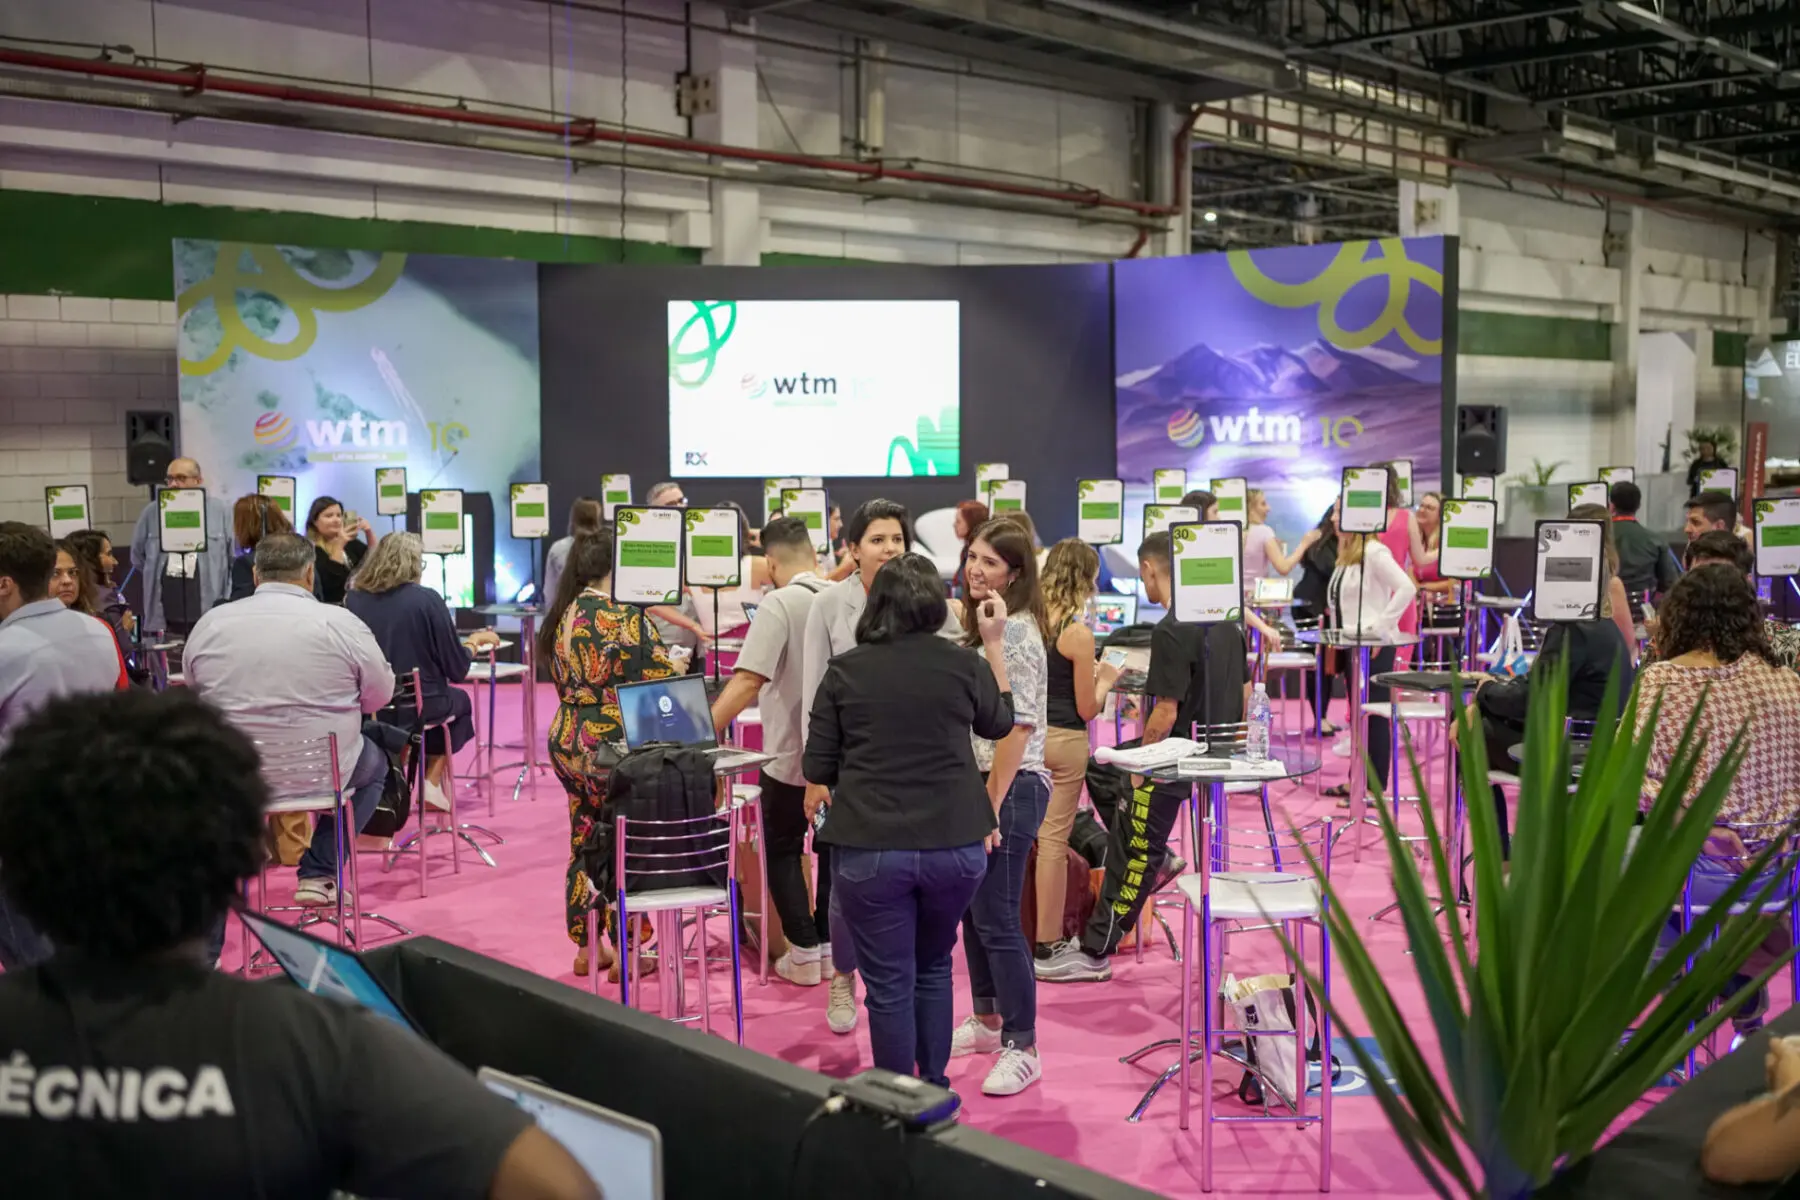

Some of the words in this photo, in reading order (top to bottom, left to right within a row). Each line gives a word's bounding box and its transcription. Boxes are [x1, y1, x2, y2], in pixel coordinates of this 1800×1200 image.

[774, 372, 837, 394] wtm
[306, 411, 408, 447] wtm
[1209, 406, 1300, 442] wtm
[685, 452, 708, 466] RX
[618, 511, 633, 522] 29
[687, 511, 699, 521] 25
[1174, 528, 1189, 540] 30
[1545, 529, 1559, 539] 31
[0, 1049, 235, 1122] ÉCNICA
